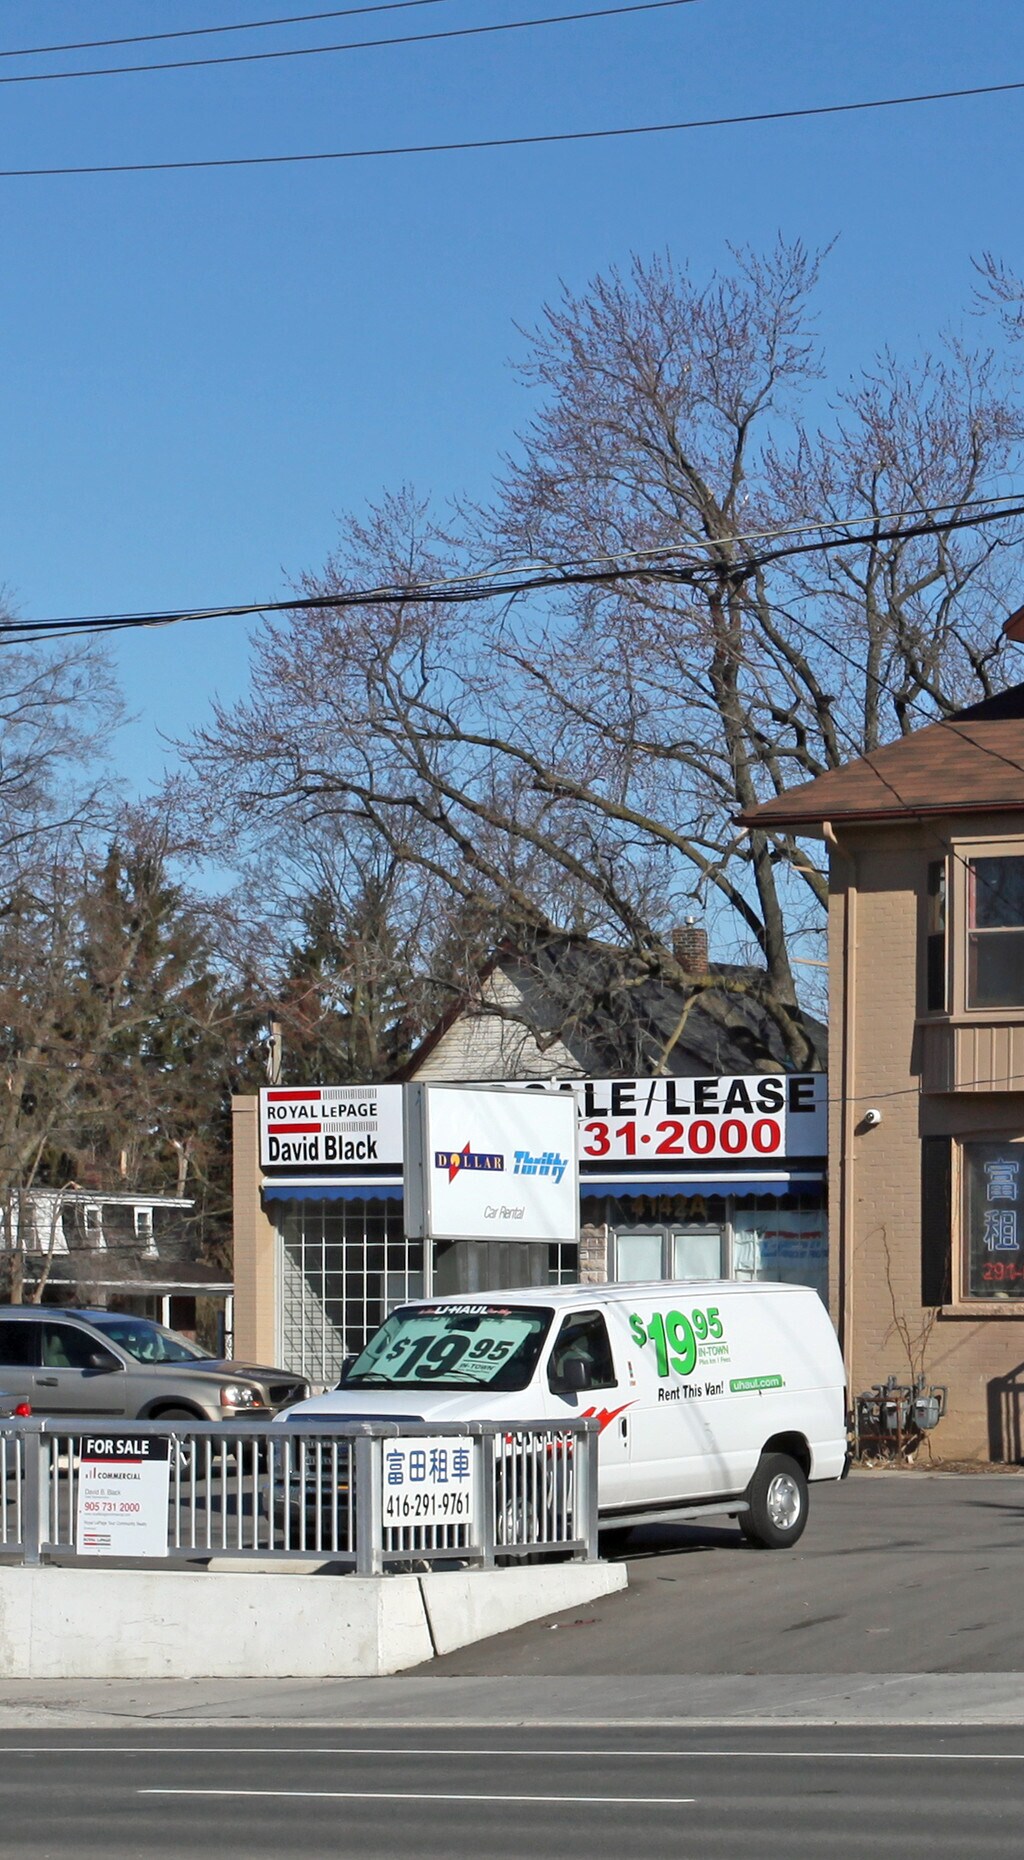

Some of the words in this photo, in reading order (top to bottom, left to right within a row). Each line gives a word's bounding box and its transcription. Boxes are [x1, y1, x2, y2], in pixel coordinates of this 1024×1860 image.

[267, 1105, 318, 1119] ROYAL
[269, 1136, 319, 1161] David
[324, 1135, 377, 1160] Black
[438, 1153, 503, 1170] DOLLAR
[513, 1151, 569, 1184] Thrifty
[484, 1206, 498, 1219] Car
[499, 1206, 525, 1219] Rental
[435, 1305, 489, 1315] U-HAUL
[699, 1344, 729, 1357] IN-TOWN
[733, 1376, 780, 1391] uhaul.com
[658, 1386, 680, 1402] Rent
[682, 1384, 702, 1399] This
[705, 1381, 724, 1396] Van!
[87, 1439, 114, 1454] FOR
[116, 1440, 150, 1454] SALE
[386, 1447, 470, 1485] 富田租車
[97, 1472, 141, 1480] COMMERCIAL
[84, 1488, 100, 1496] David
[84, 1502, 100, 1511] 905
[102, 1502, 117, 1512] 731
[119, 1502, 140, 1512] 2000
[386, 1492, 470, 1517] 416-291-9761
